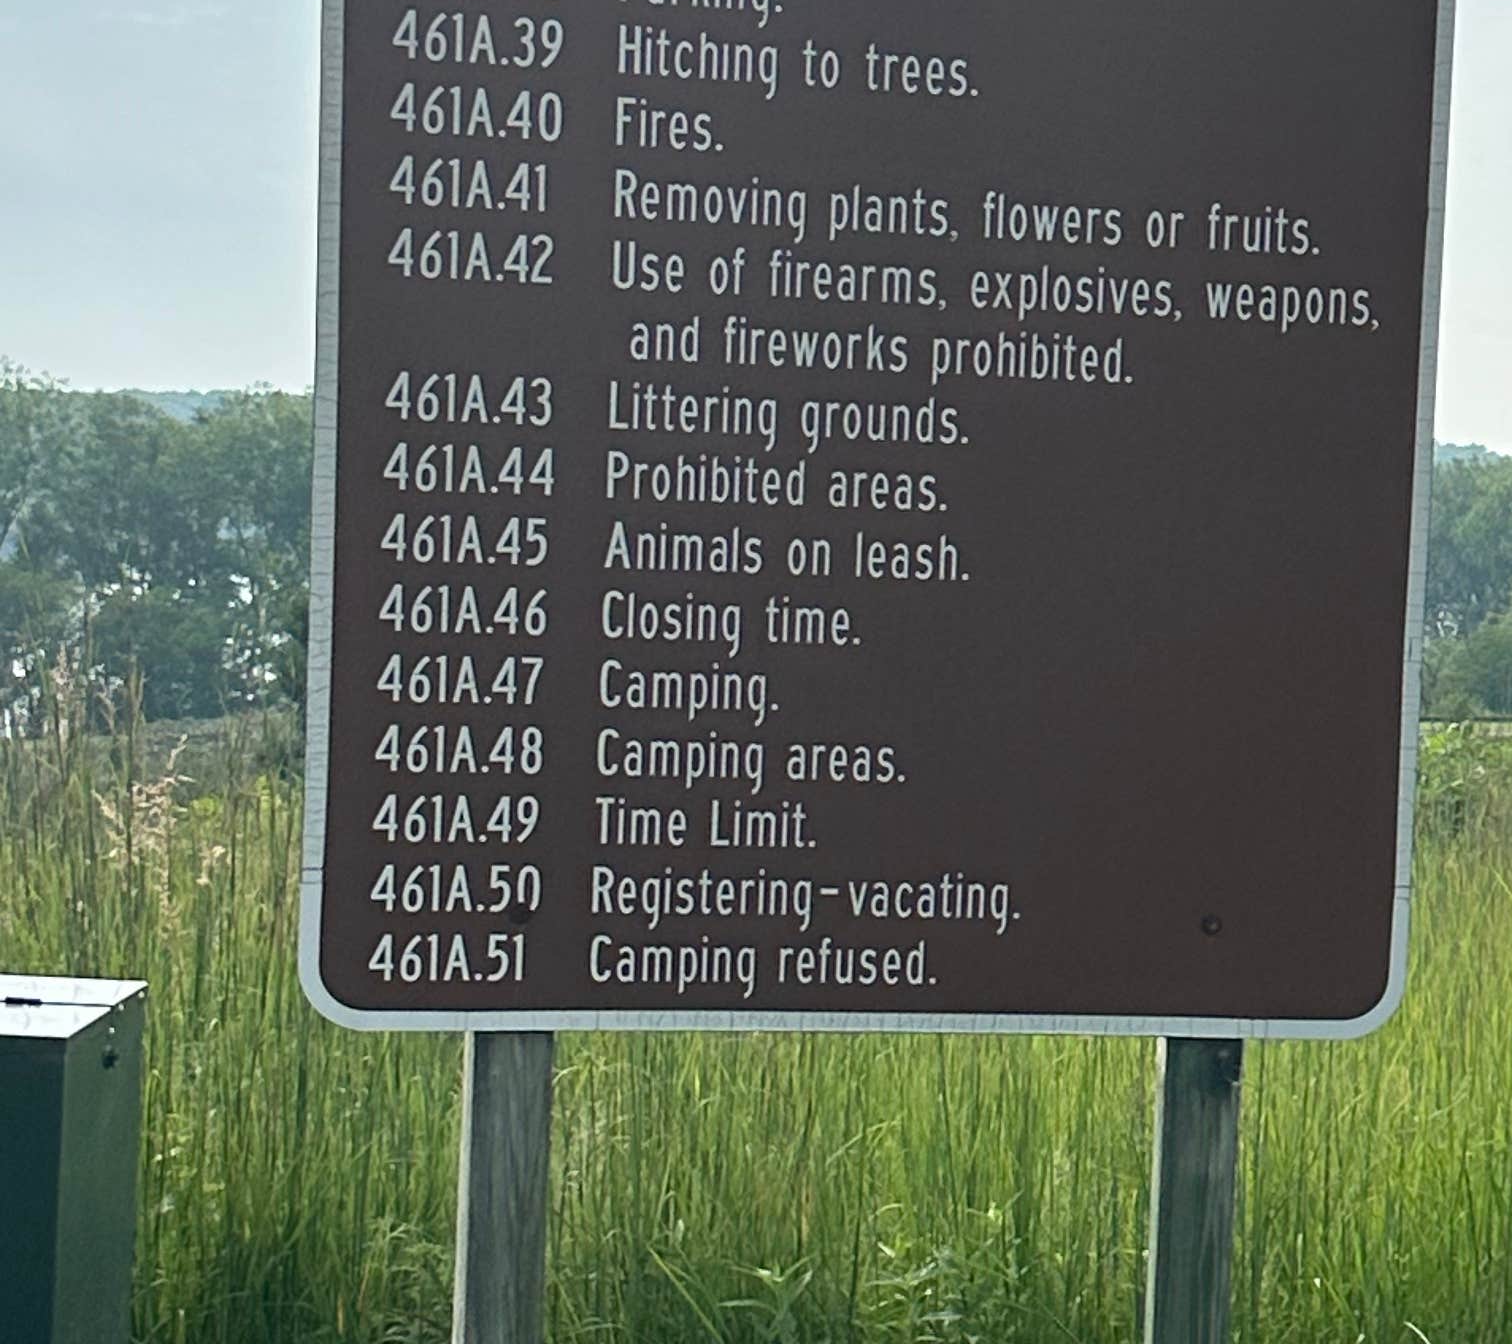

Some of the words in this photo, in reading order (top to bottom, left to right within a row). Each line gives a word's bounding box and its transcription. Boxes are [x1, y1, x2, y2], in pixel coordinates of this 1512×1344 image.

[392, 9, 563, 68] 461A.39
[618, 24, 777, 100] Hitching
[802, 39, 839, 89] to
[865, 43, 979, 97] trees.
[390, 82, 562, 142] 461A.40
[616, 96, 724, 152] Fires.
[389, 155, 546, 212] 461A.41
[614, 168, 806, 244] Removing
[829, 184, 958, 242] plants,
[983, 190, 1122, 246] flowers
[1146, 210, 1185, 248] or
[1208, 202, 1320, 255] fruits.
[387, 227, 553, 284] 461A.42
[613, 240, 684, 293] Use
[709, 247, 745, 295] of
[769, 249, 946, 311] firearms,
[971, 265, 1182, 321] explosives,
[1206, 282, 1379, 333] weapons,
[630, 315, 699, 363] and
[724, 315, 908, 373] fireworks
[931, 331, 1133, 385] prohibited.
[385, 371, 552, 426] 461A.43
[609, 380, 777, 452] Littering
[801, 397, 969, 454] grounds.
[383, 442, 555, 496] 461A.44
[606, 450, 806, 506] Prohibited
[828, 471, 947, 511] areas.
[380, 513, 548, 566] 461A.45
[604, 521, 762, 574] Animals
[787, 538, 831, 576] on
[855, 531, 969, 581] leash.
[378, 583, 547, 636] 461A.46
[602, 590, 741, 658] Closing
[765, 596, 860, 646] time.
[376, 654, 544, 705] 461A.47
[600, 659, 779, 727] Camping.
[374, 724, 543, 775] 461A.48
[597, 728, 763, 795] Camping
[786, 744, 905, 783] areas.
[372, 794, 539, 843] 461A.49
[595, 797, 687, 846] Time
[710, 799, 816, 848] Limit.
[370, 864, 541, 913] 461A.50
[591, 866, 1020, 935] Registering-vacating.
[368, 933, 524, 982] 461A.51
[590, 935, 756, 999] Camping
[778, 937, 937, 985] refused.
